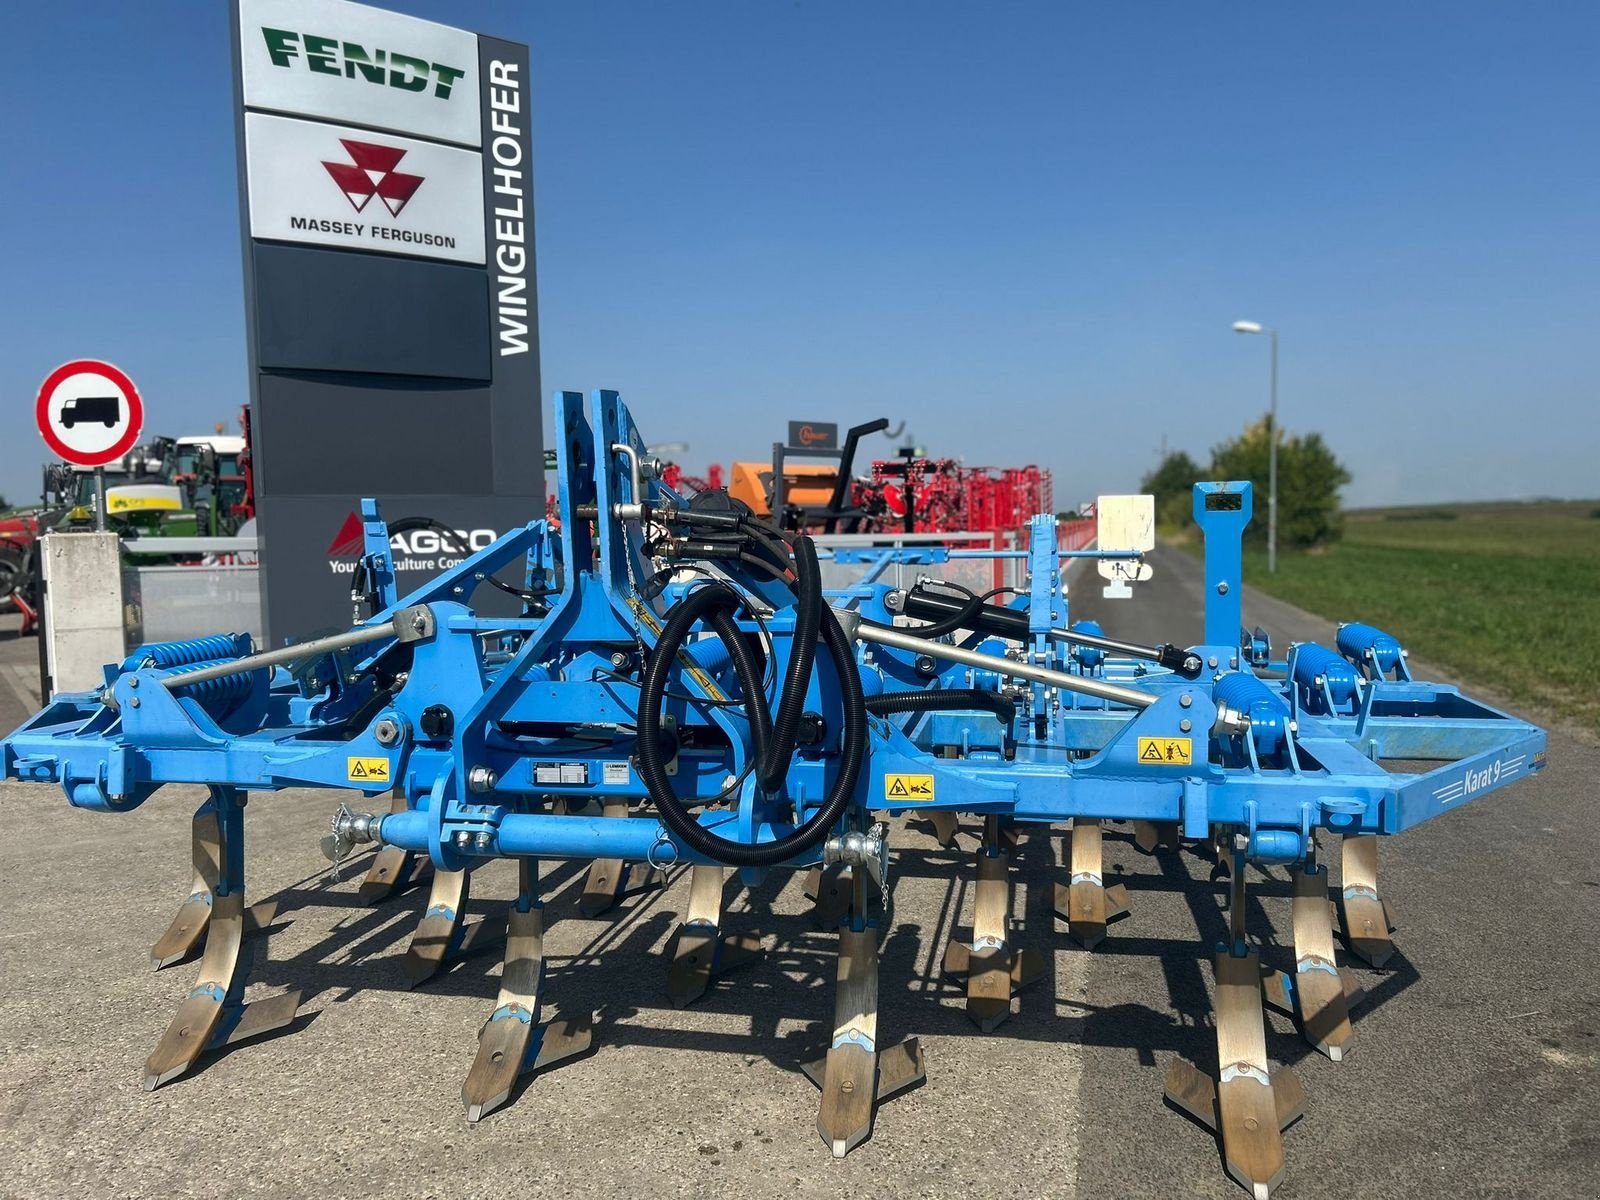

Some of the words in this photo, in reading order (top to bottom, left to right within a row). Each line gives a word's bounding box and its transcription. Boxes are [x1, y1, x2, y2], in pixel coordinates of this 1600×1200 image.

[261, 26, 465, 101] FENDT
[489, 60, 529, 357] WINGELHOFER
[290, 216, 364, 237] MASSEY
[371, 226, 456, 249] FERGUSON
[390, 528, 497, 554] AGCO
[329, 560, 357, 574] You
[393, 557, 435, 571] ulture
[1464, 764, 1492, 795] Karat
[1493, 760, 1501, 782] 9
